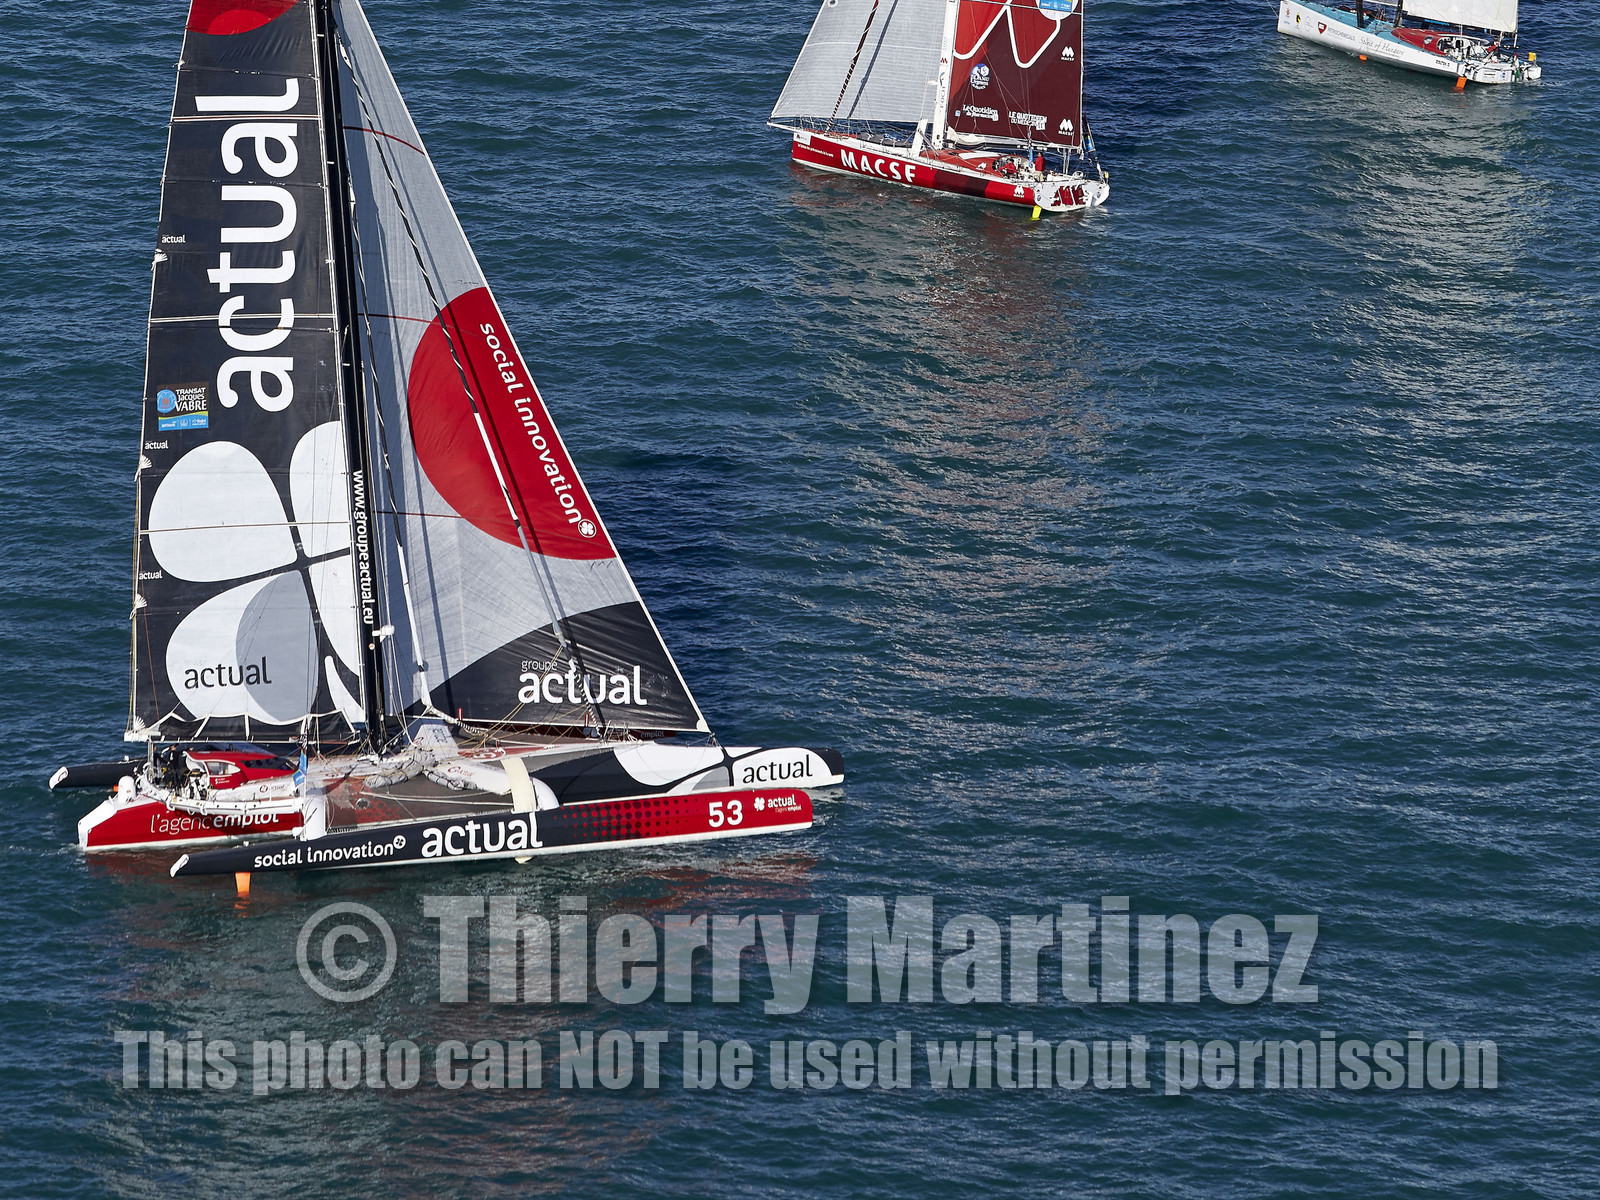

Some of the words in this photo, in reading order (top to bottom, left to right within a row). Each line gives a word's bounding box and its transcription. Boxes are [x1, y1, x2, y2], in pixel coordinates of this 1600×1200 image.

[840, 149, 917, 183] MACSF
[161, 234, 186, 243] actual
[195, 78, 300, 412] actual
[175, 387, 206, 395] TRANSAT
[174, 400, 207, 412] VABRE
[480, 322, 524, 393] social
[514, 397, 582, 524] innovation
[144, 440, 169, 449] actual
[353, 470, 375, 625] www.groupeactual.eu
[138, 570, 163, 580] actual
[184, 657, 272, 689] actual
[521, 660, 558, 673] groupe
[518, 665, 648, 705] actual
[743, 754, 813, 784] actual
[708, 800, 744, 828] 53
[767, 794, 796, 809] actual
[422, 812, 543, 858] actual
[254, 848, 303, 868] social
[307, 843, 394, 863] innovation
